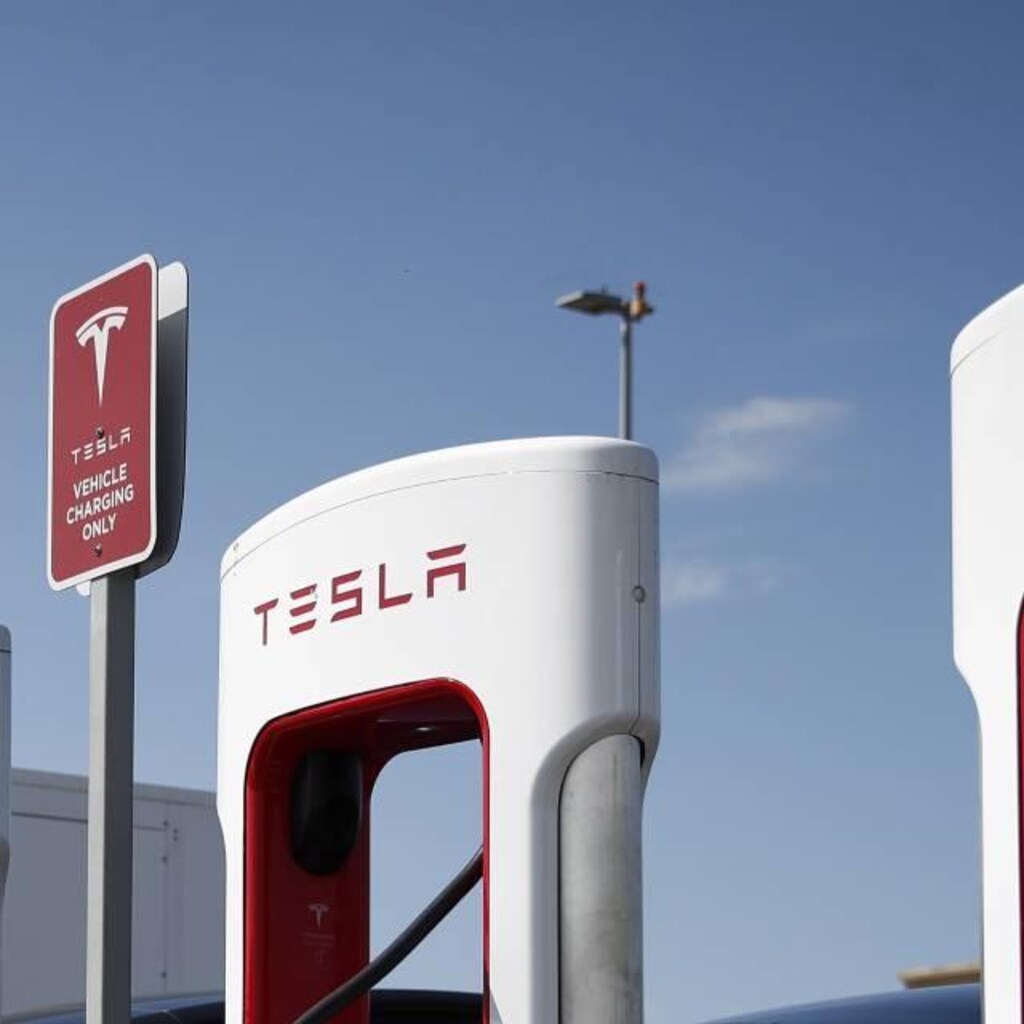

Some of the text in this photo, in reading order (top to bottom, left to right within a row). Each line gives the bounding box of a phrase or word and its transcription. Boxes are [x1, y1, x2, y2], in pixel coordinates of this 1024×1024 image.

[71, 426, 131, 465] TESLA
[73, 462, 127, 499] VEHICLE
[66, 484, 134, 524] CHARGING
[82, 513, 116, 540] ONLY
[254, 543, 466, 646] TESLA
